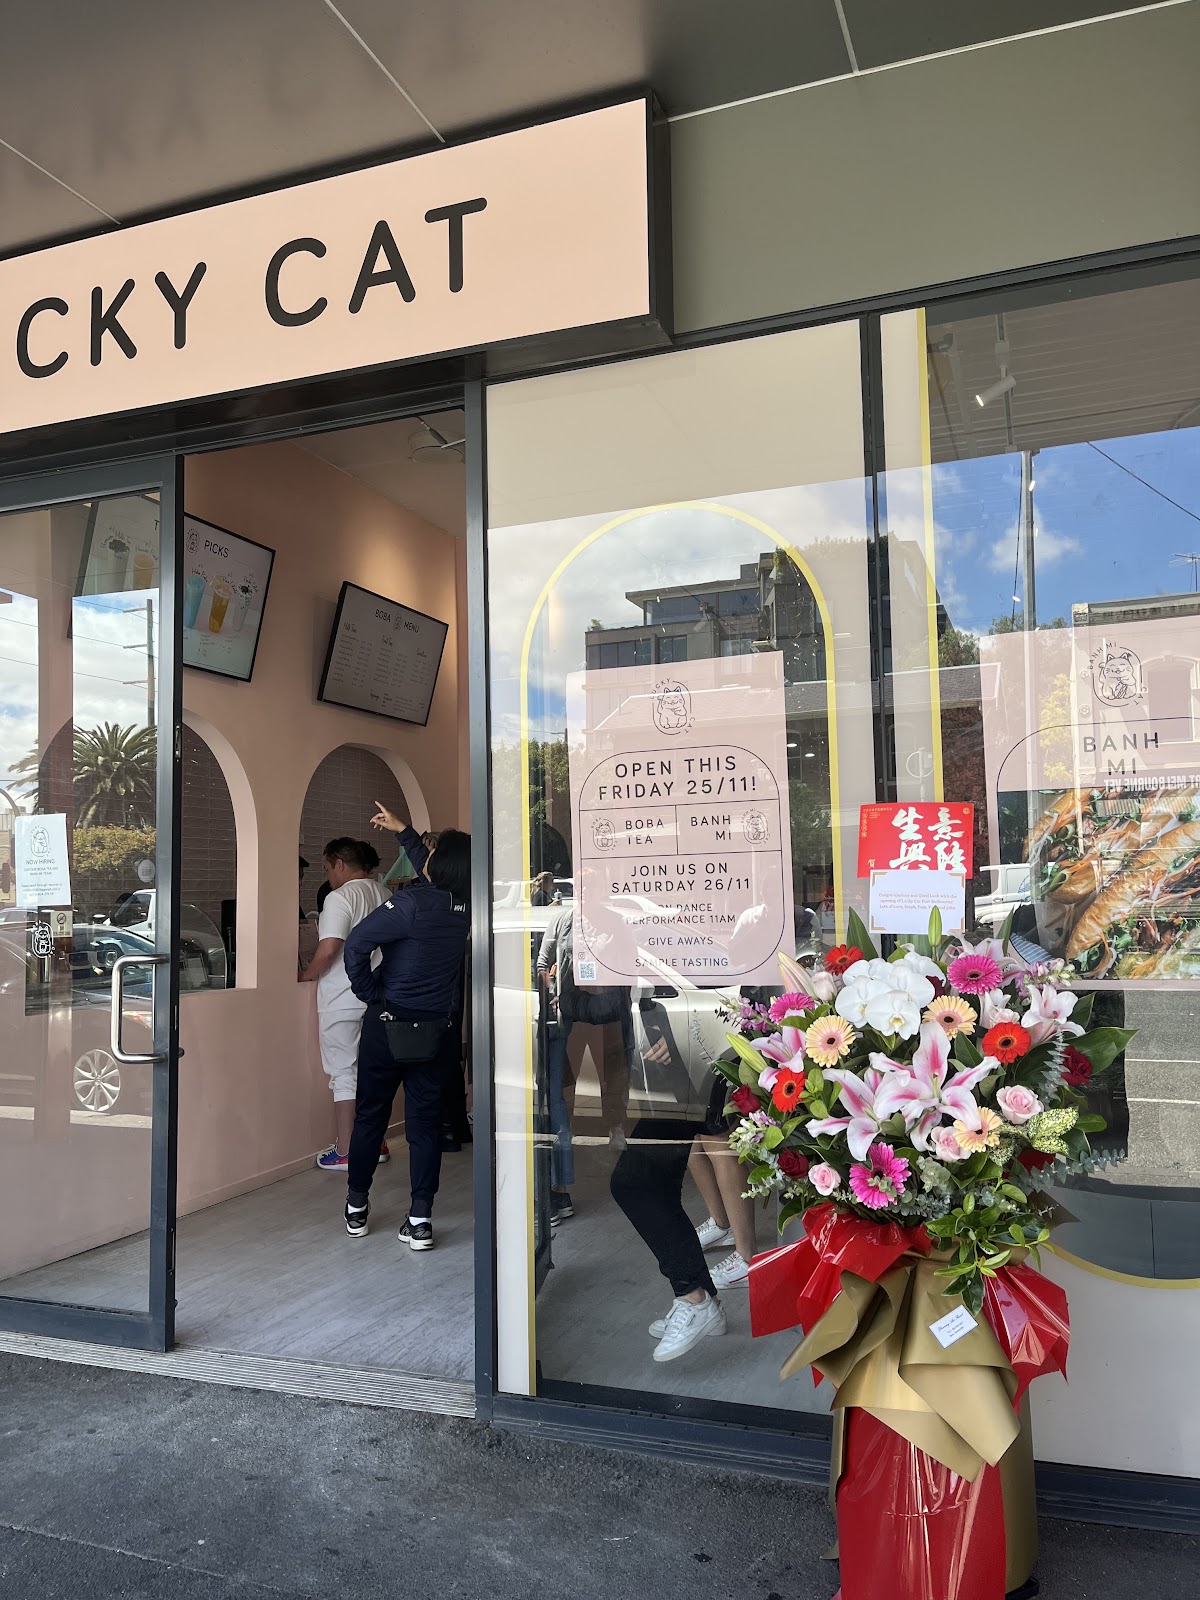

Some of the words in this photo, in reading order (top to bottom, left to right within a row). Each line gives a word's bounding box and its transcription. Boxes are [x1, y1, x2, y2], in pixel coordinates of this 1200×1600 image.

[16, 261, 207, 379] CKY
[264, 197, 487, 327] CAT
[203, 539, 230, 559] PICKS
[375, 608, 391, 623] BOBA
[403, 621, 420, 633] MENU
[1088, 647, 1104, 670] BANH
[1133, 686, 1148, 706] CAT
[1083, 732, 1159, 753] BANH
[615, 759, 672, 778] OPEN
[684, 756, 736, 773] THIS
[1107, 758, 1137, 775] MI
[599, 781, 674, 801] FRIDAY
[687, 776, 757, 796] 25/11!
[625, 818, 664, 830] BOBA
[690, 814, 731, 827] BANH
[891, 806, 966, 841] 生意
[626, 835, 653, 845] TEA
[715, 830, 732, 841] MI
[630, 865, 668, 878] JOIN
[676, 863, 696, 876] US
[706, 862, 728, 875] ON
[611, 879, 695, 895] SATURDAY
[704, 877, 751, 892] 26/11
[625, 914, 705, 926] PERFORMANCE
[709, 913, 736, 924] 11AM
[648, 936, 673, 947] GIVE
[677, 936, 714, 947] AWAYS
[681, 957, 728, 968] TASTING
